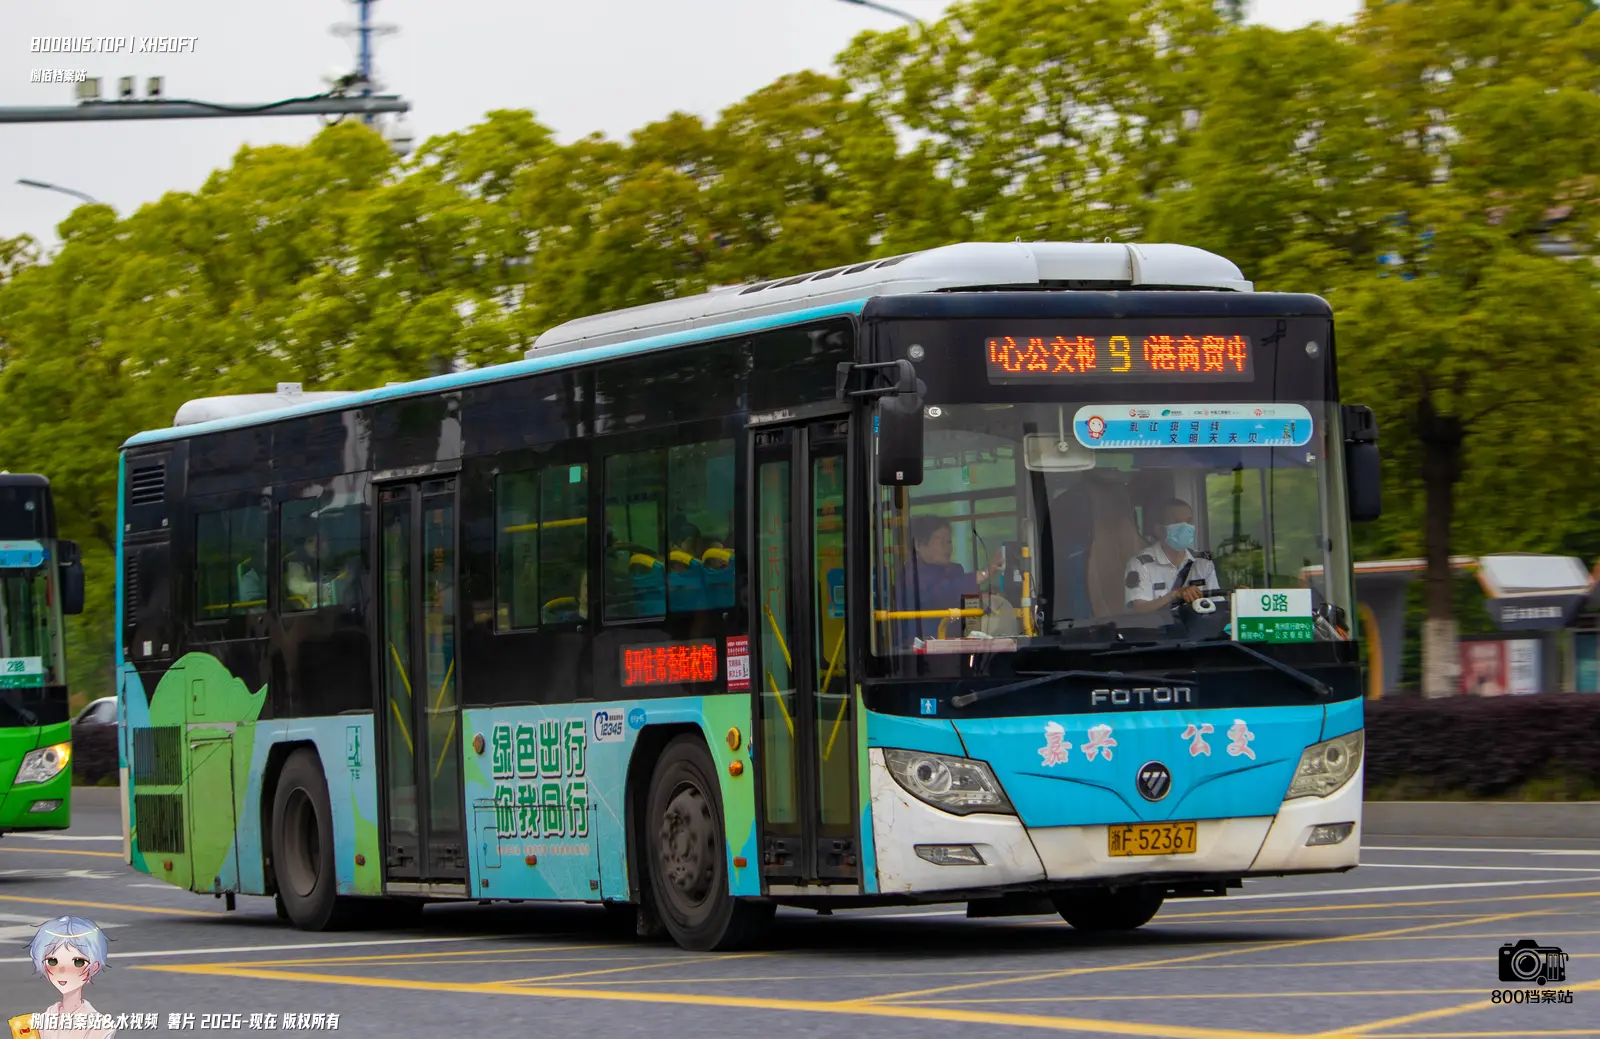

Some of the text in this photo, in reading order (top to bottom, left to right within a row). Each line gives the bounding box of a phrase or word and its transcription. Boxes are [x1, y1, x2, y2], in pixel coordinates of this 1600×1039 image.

[1109, 335, 1132, 372] 9
[1129, 421, 1220, 432] 礼让斑马线
[1169, 433, 1258, 444] 文明天天见
[1261, 594, 1288, 612] 9路
[1091, 687, 1192, 706] FOTON
[601, 722, 622, 736] 12345
[492, 717, 587, 779] 绿色出行
[1037, 719, 1256, 767] 嘉兴 公交
[494, 782, 588, 838] 你我同行
